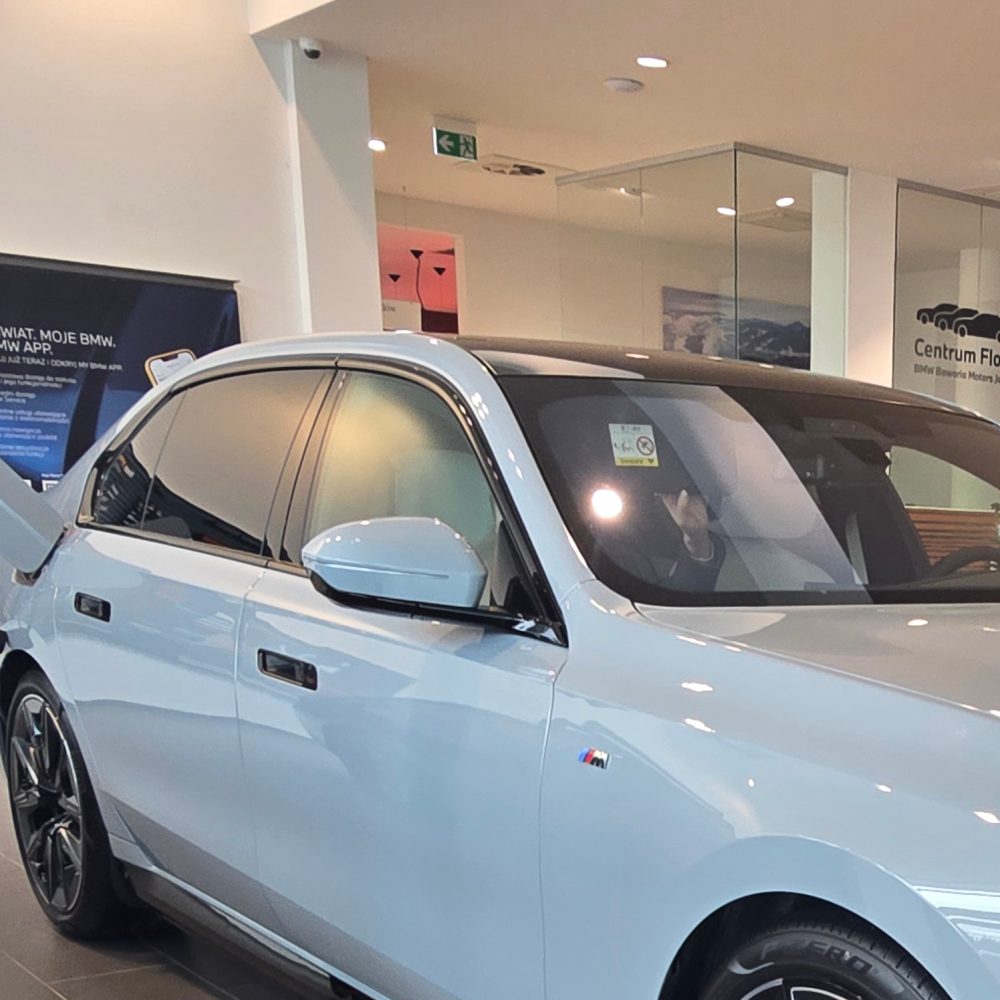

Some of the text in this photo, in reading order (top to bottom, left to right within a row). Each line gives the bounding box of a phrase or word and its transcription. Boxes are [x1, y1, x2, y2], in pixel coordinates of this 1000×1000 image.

[23, 341, 54, 355] APP.
[40, 329, 77, 345] MOJE
[80, 333, 117, 348] BMW.
[914, 338, 976, 364] Centrum
[914, 364, 934, 375] BMW
[968, 371, 993, 383] Motors
